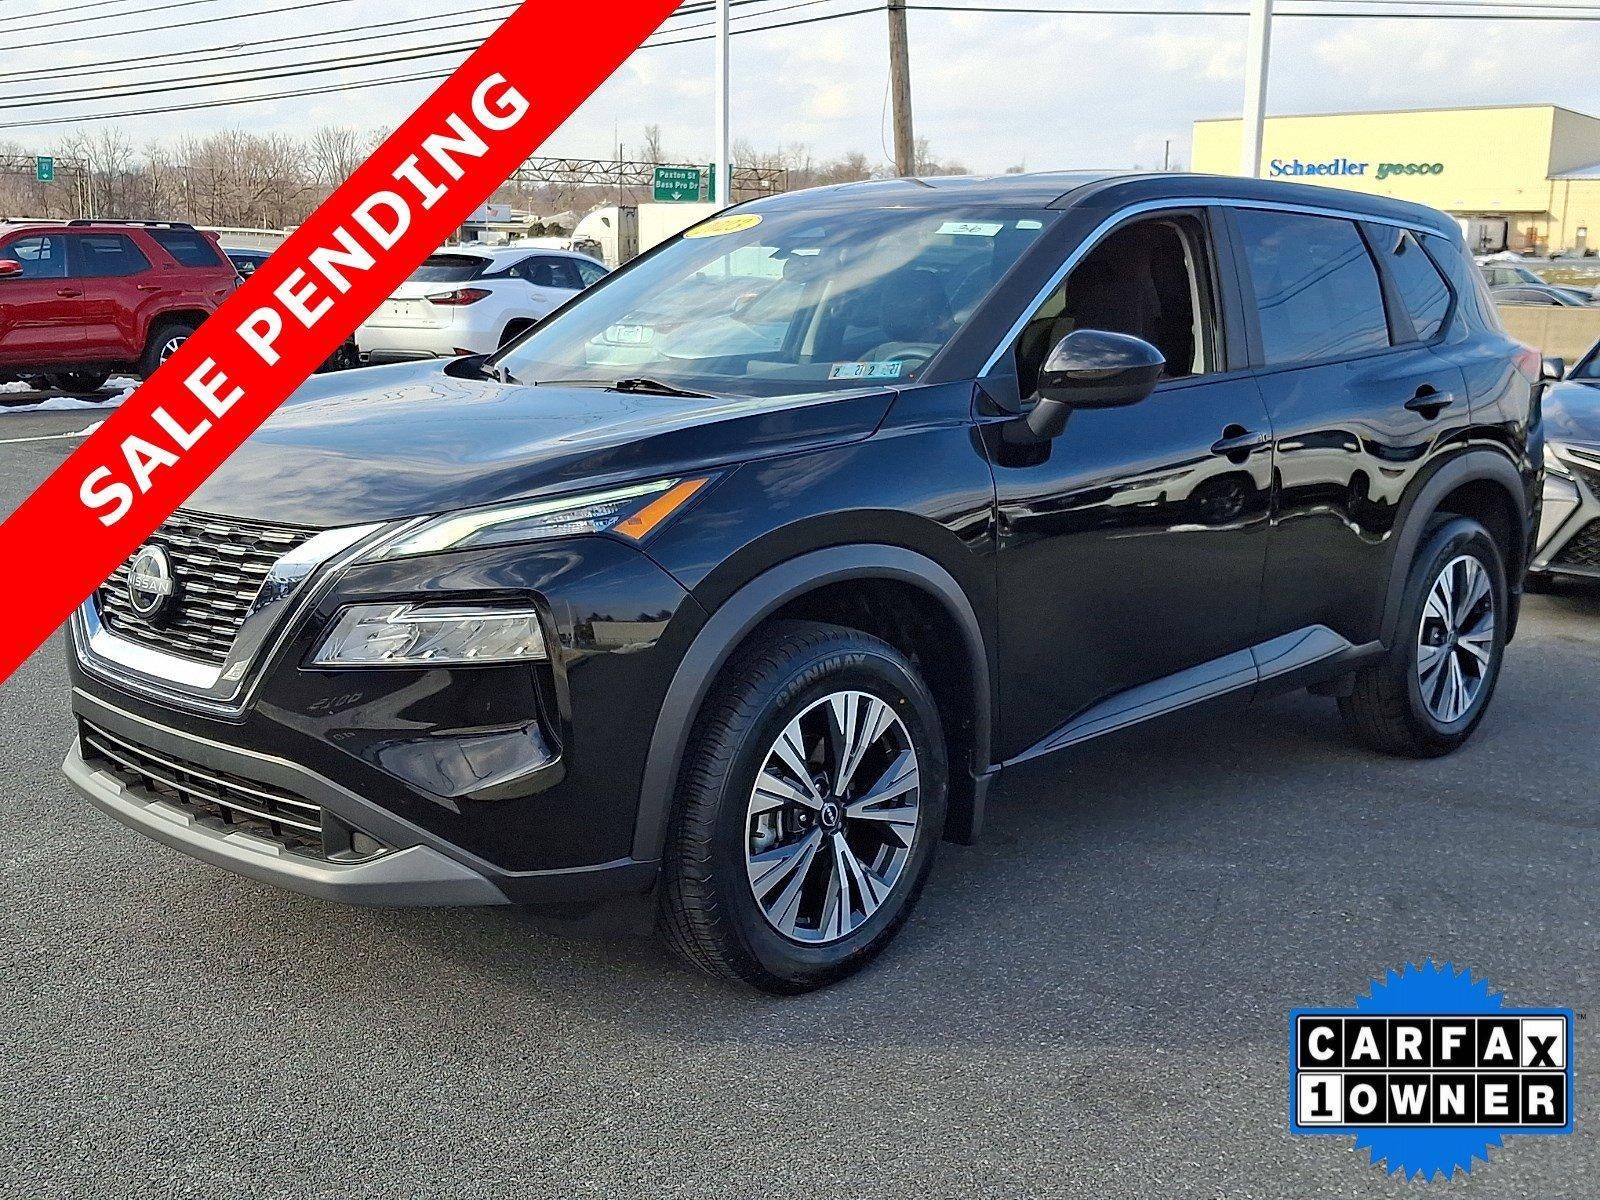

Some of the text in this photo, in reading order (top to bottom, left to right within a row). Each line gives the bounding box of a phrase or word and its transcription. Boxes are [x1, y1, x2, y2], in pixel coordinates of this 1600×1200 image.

[659, 170, 696, 180] Paxton St
[1269, 158, 1369, 178] Schaedler
[656, 180, 699, 190] Bass Pro Dr
[129, 573, 169, 592] NISSAN
